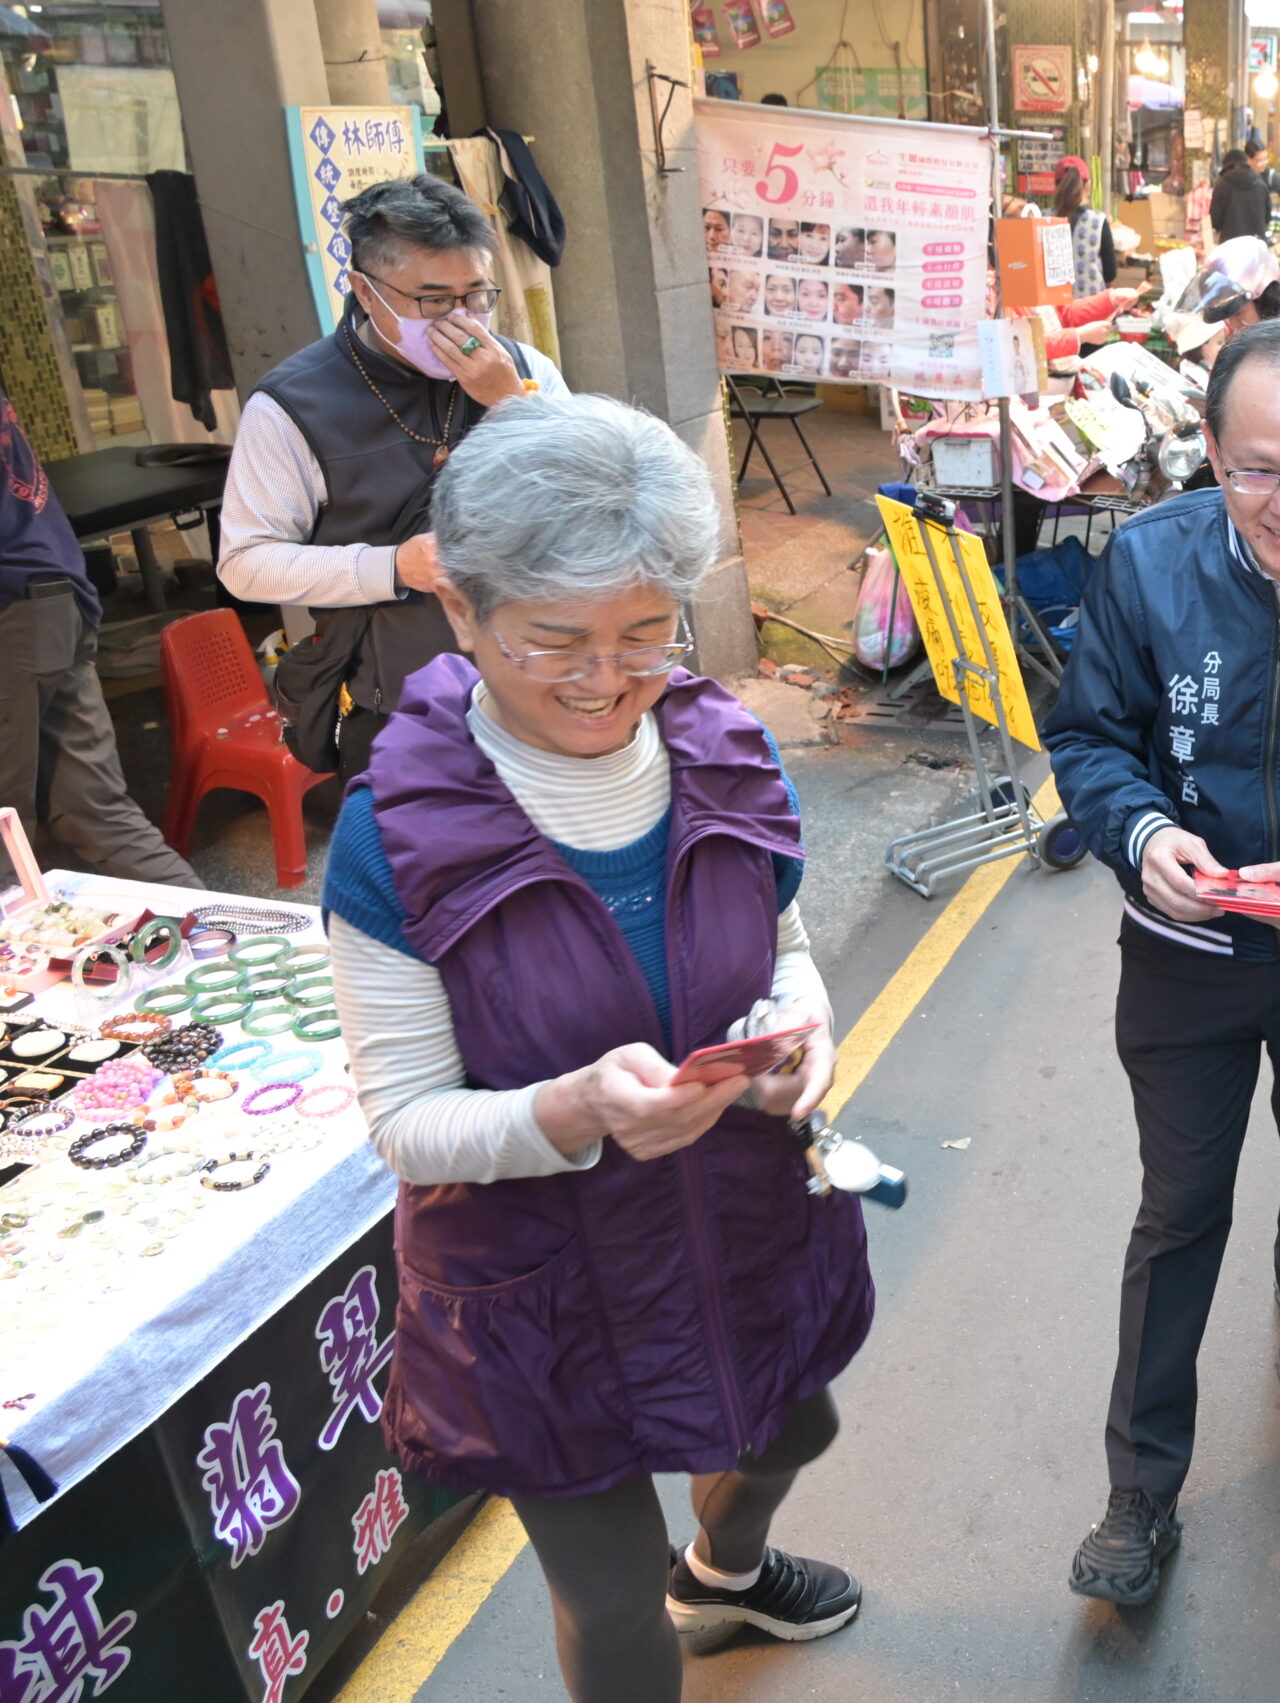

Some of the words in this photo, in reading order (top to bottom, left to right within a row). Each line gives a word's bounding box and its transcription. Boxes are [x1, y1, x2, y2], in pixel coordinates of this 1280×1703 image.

[342, 119, 405, 156] 林師傅
[722, 158, 755, 178] 只要
[756, 142, 804, 205] 5
[1201, 651, 1222, 727] 分局長
